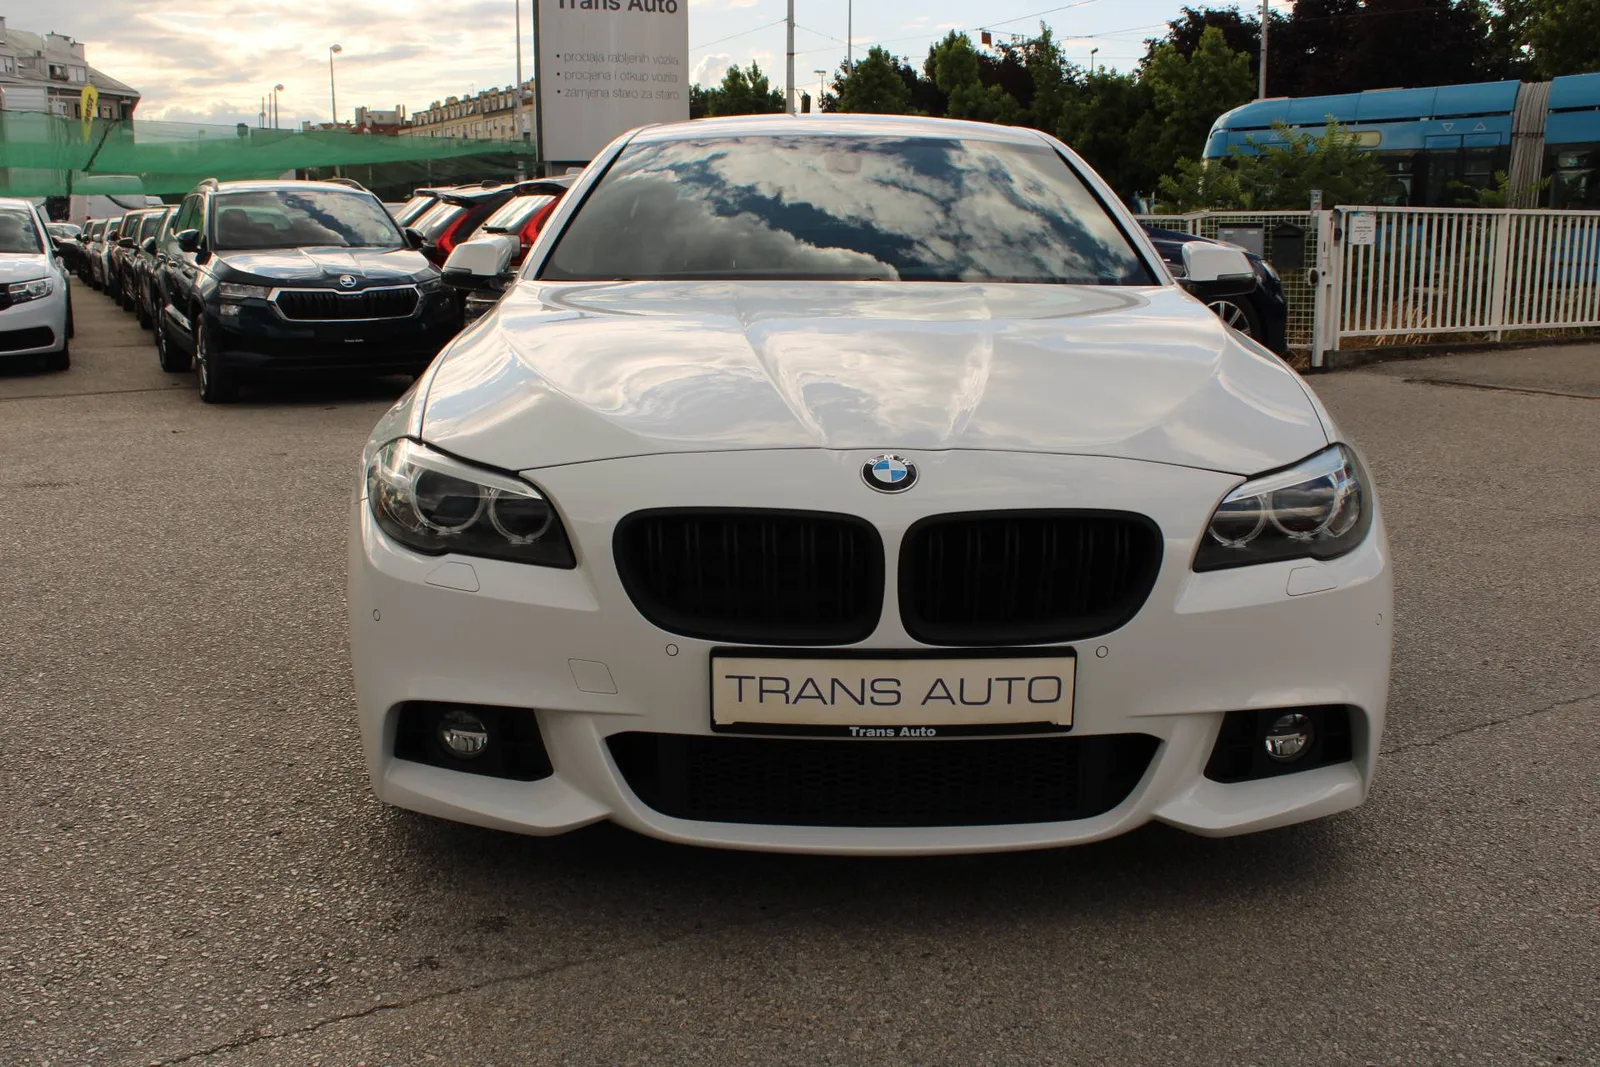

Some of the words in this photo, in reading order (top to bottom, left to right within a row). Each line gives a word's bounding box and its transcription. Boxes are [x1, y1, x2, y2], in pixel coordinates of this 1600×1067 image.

[627, 0, 678, 13] Auto
[564, 52, 605, 64] prodaja
[607, 52, 650, 65] rabljenih
[652, 53, 679, 65] vozila
[564, 70, 611, 82] procjena
[619, 71, 649, 82] otkup
[651, 72, 678, 82] vozila
[564, 88, 609, 99] zamjena
[612, 88, 638, 99] staro
[640, 91, 653, 99] za
[656, 89, 680, 100] staro
[724, 675, 901, 706] TRANS
[920, 675, 1062, 706] AUTO
[849, 726, 895, 737] Trans
[899, 726, 937, 737] Auto
